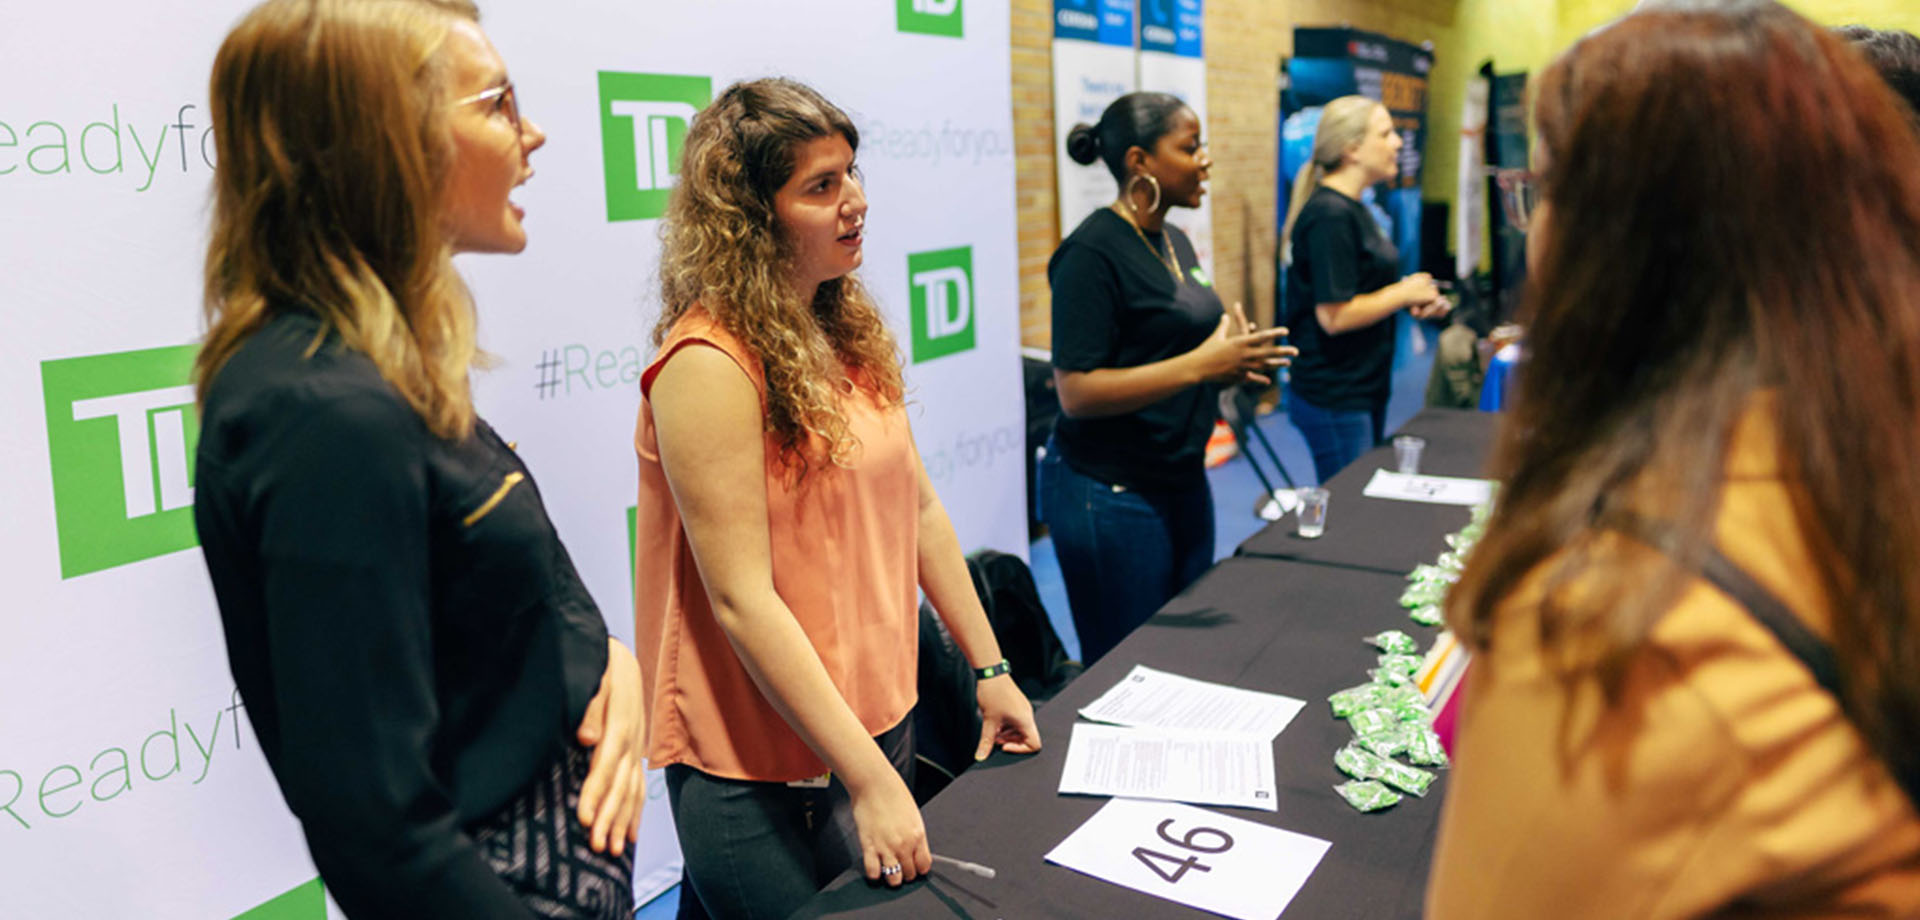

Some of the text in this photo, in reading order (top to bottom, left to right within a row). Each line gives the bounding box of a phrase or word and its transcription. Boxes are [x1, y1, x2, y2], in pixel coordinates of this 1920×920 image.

[914, 267, 970, 340] TD
[534, 343, 648, 400] #Rea
[1131, 818, 1234, 884] 46
